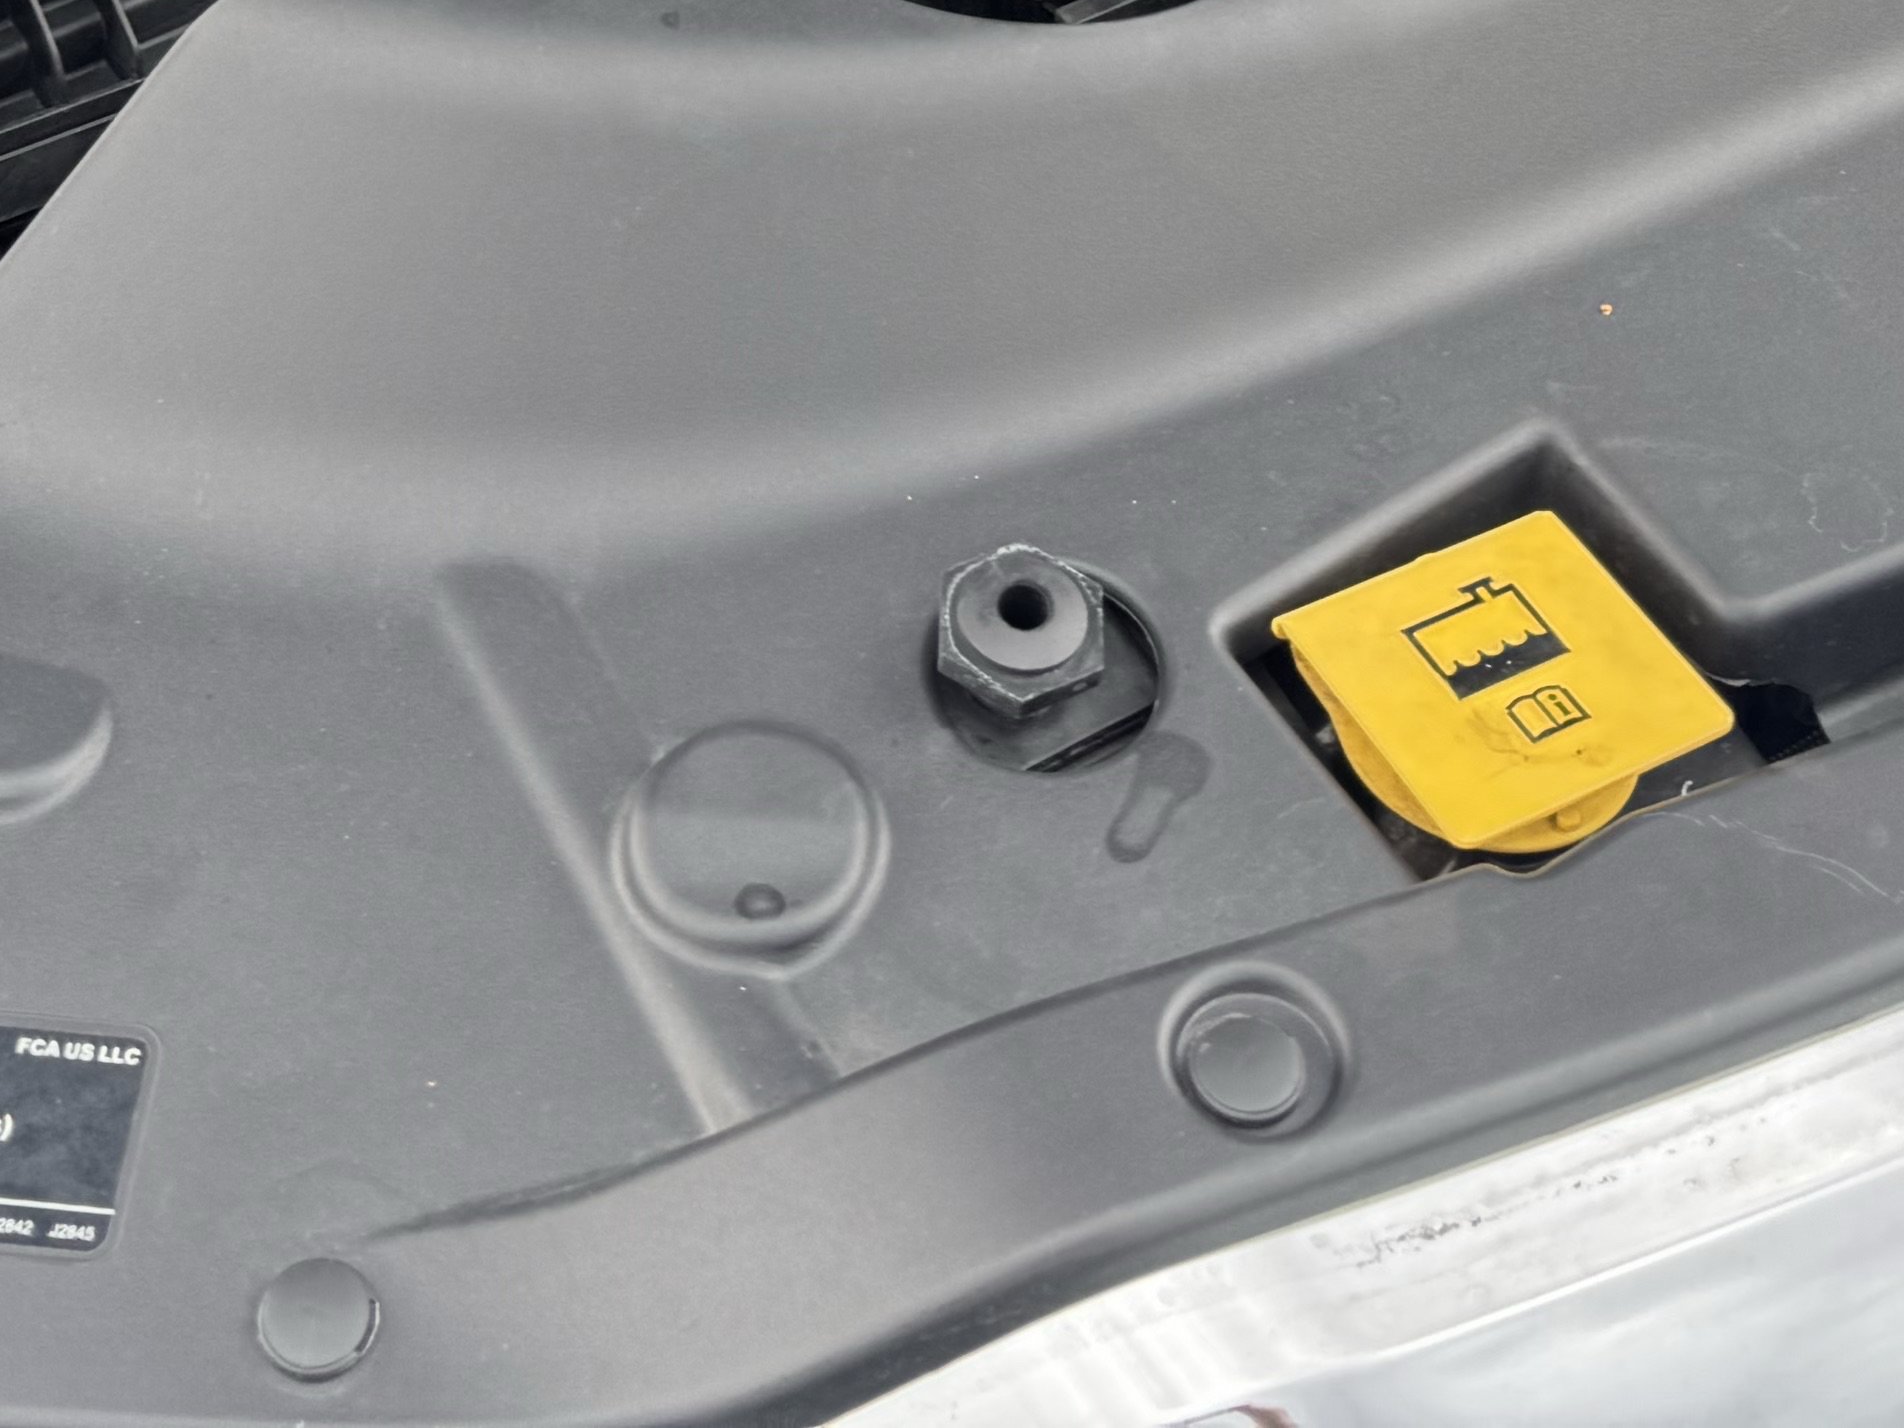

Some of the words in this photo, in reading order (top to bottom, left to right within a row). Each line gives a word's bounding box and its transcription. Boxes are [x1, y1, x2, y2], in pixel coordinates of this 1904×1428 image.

[14, 1036, 61, 1060] FCA
[63, 1041, 95, 1062] US
[96, 1044, 143, 1067] LLC
